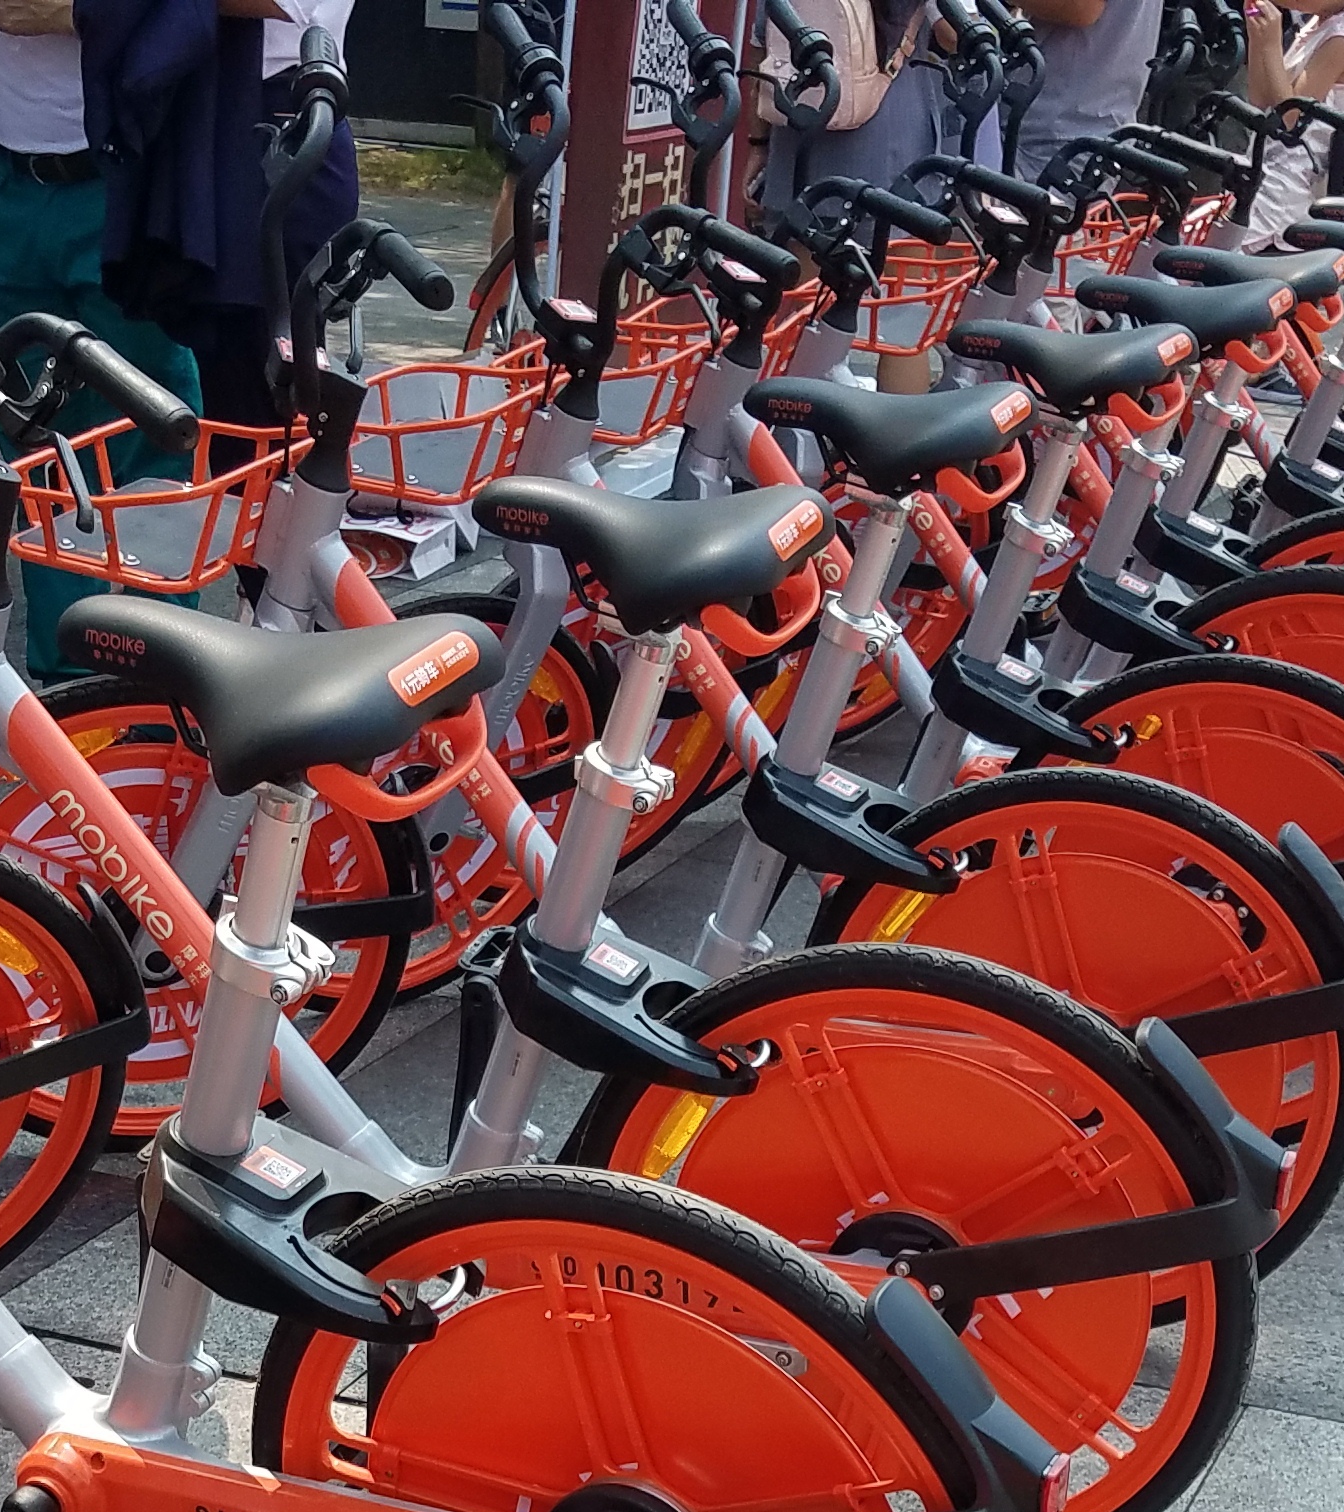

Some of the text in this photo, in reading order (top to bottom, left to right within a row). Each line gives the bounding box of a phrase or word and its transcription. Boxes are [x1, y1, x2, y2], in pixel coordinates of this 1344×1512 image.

[619, 143, 685, 221] 扫一扫
[767, 398, 813, 414] mobike
[496, 505, 550, 526] mobike
[85, 628, 146, 655] mobike
[48, 789, 174, 941] mobike
